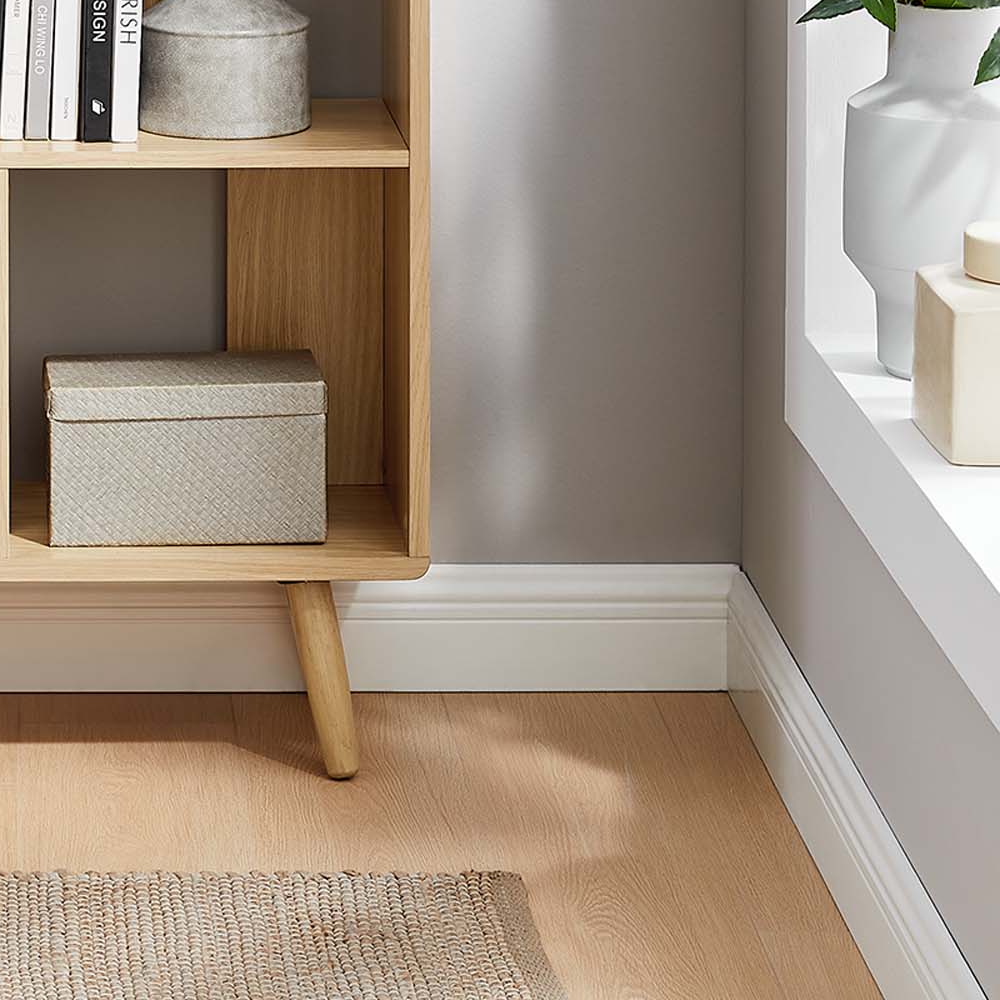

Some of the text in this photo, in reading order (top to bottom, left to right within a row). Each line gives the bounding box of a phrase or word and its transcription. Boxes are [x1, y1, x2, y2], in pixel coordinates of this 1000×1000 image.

[36, 4, 48, 25] CHI
[35, 25, 47, 57] WING
[34, 59, 45, 76] LO
